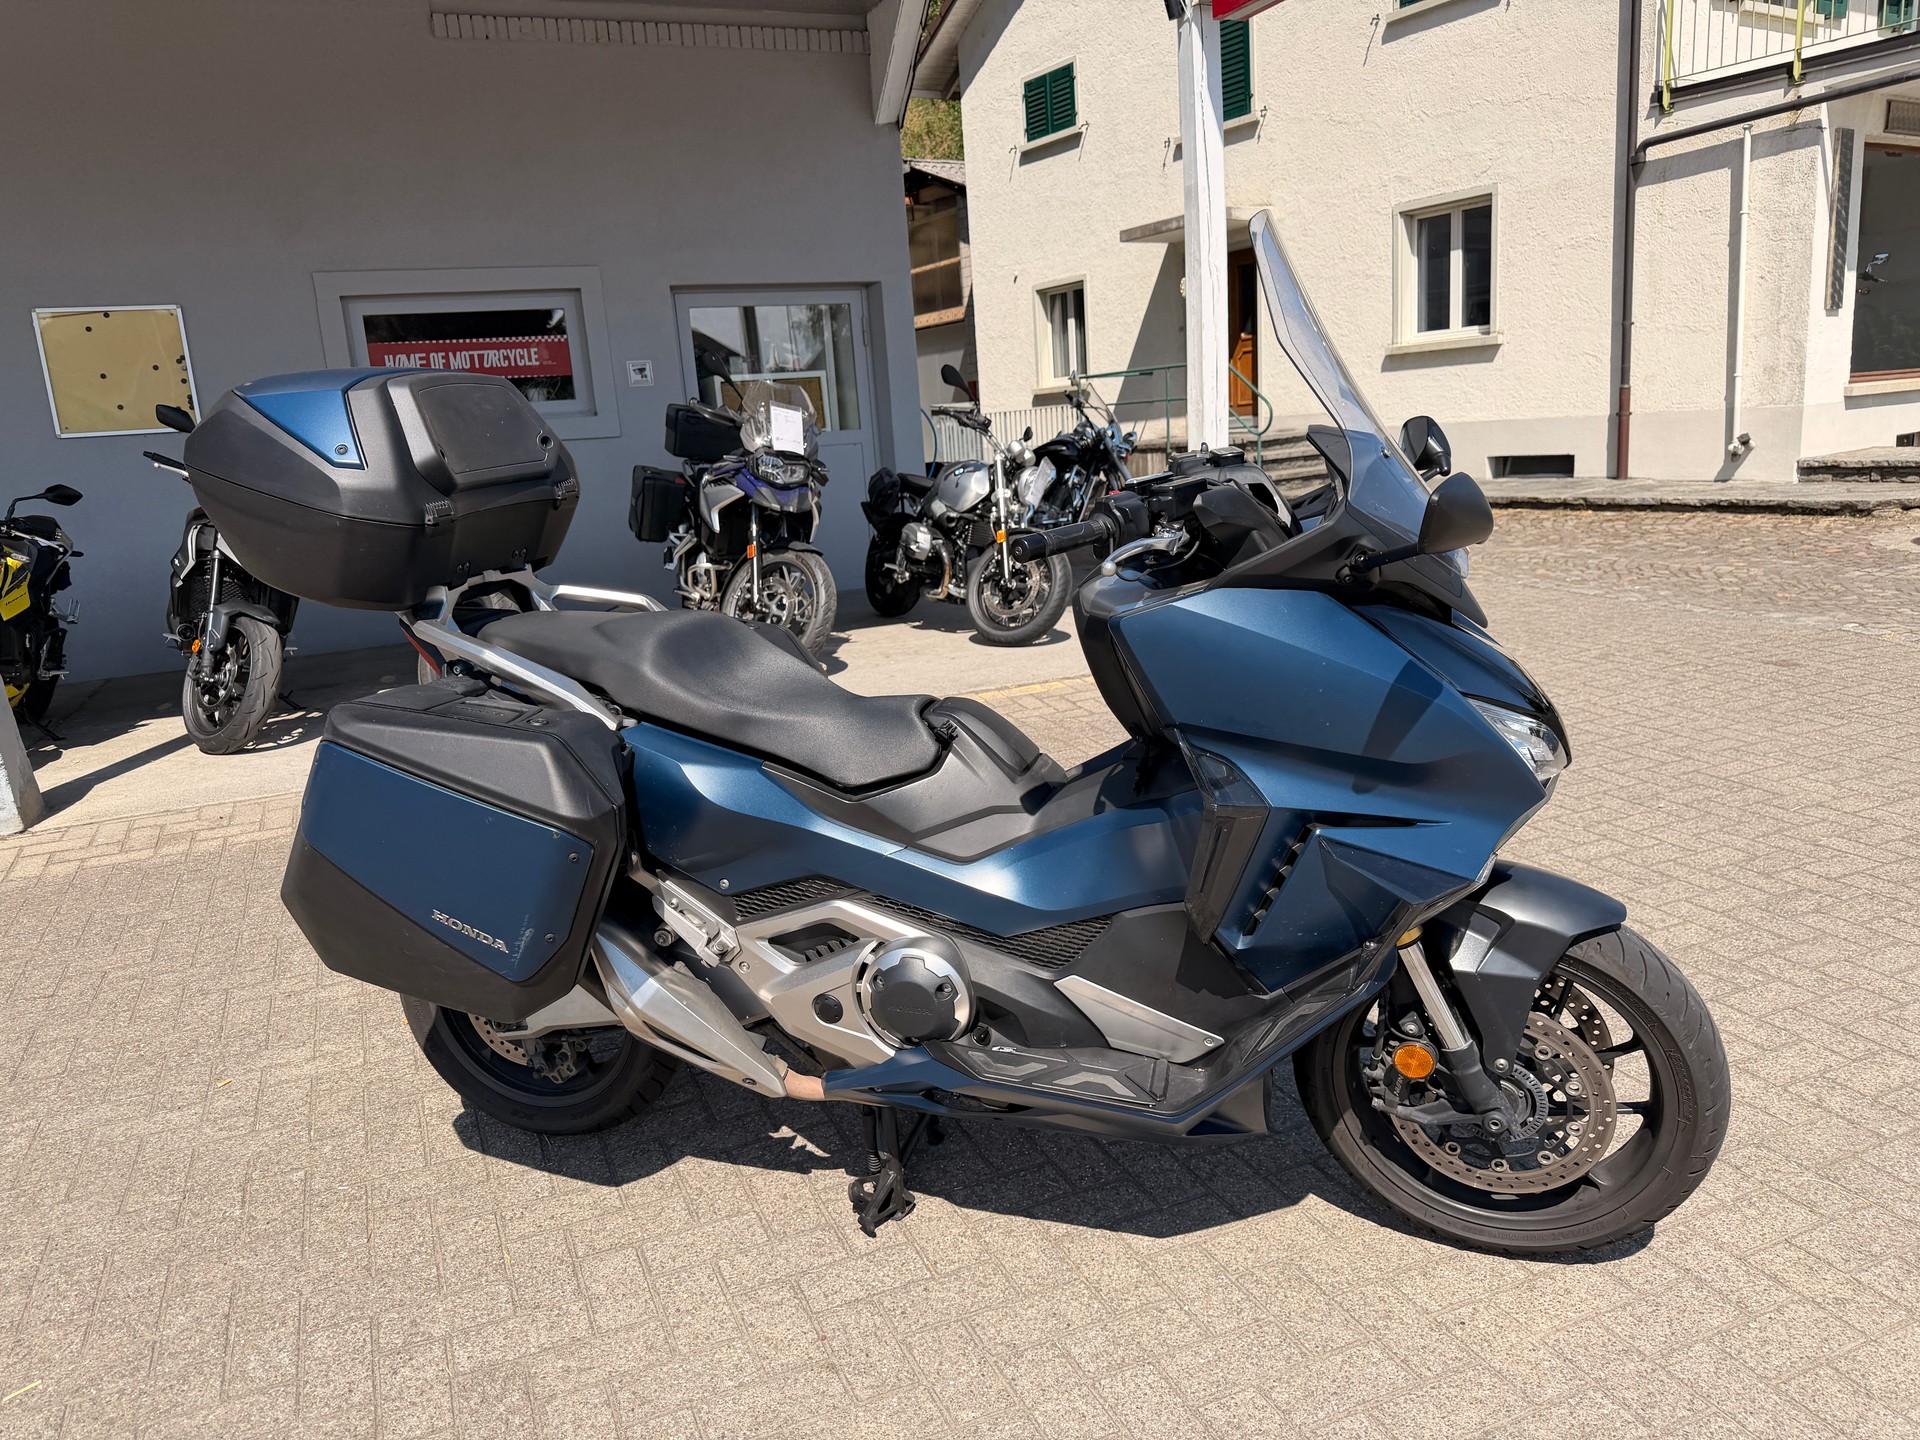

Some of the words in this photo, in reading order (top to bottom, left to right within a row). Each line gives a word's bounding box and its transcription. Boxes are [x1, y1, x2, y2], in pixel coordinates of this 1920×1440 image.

[384, 352, 427, 368] HOME
[429, 351, 446, 369] OF
[431, 908, 509, 954] HONDA
